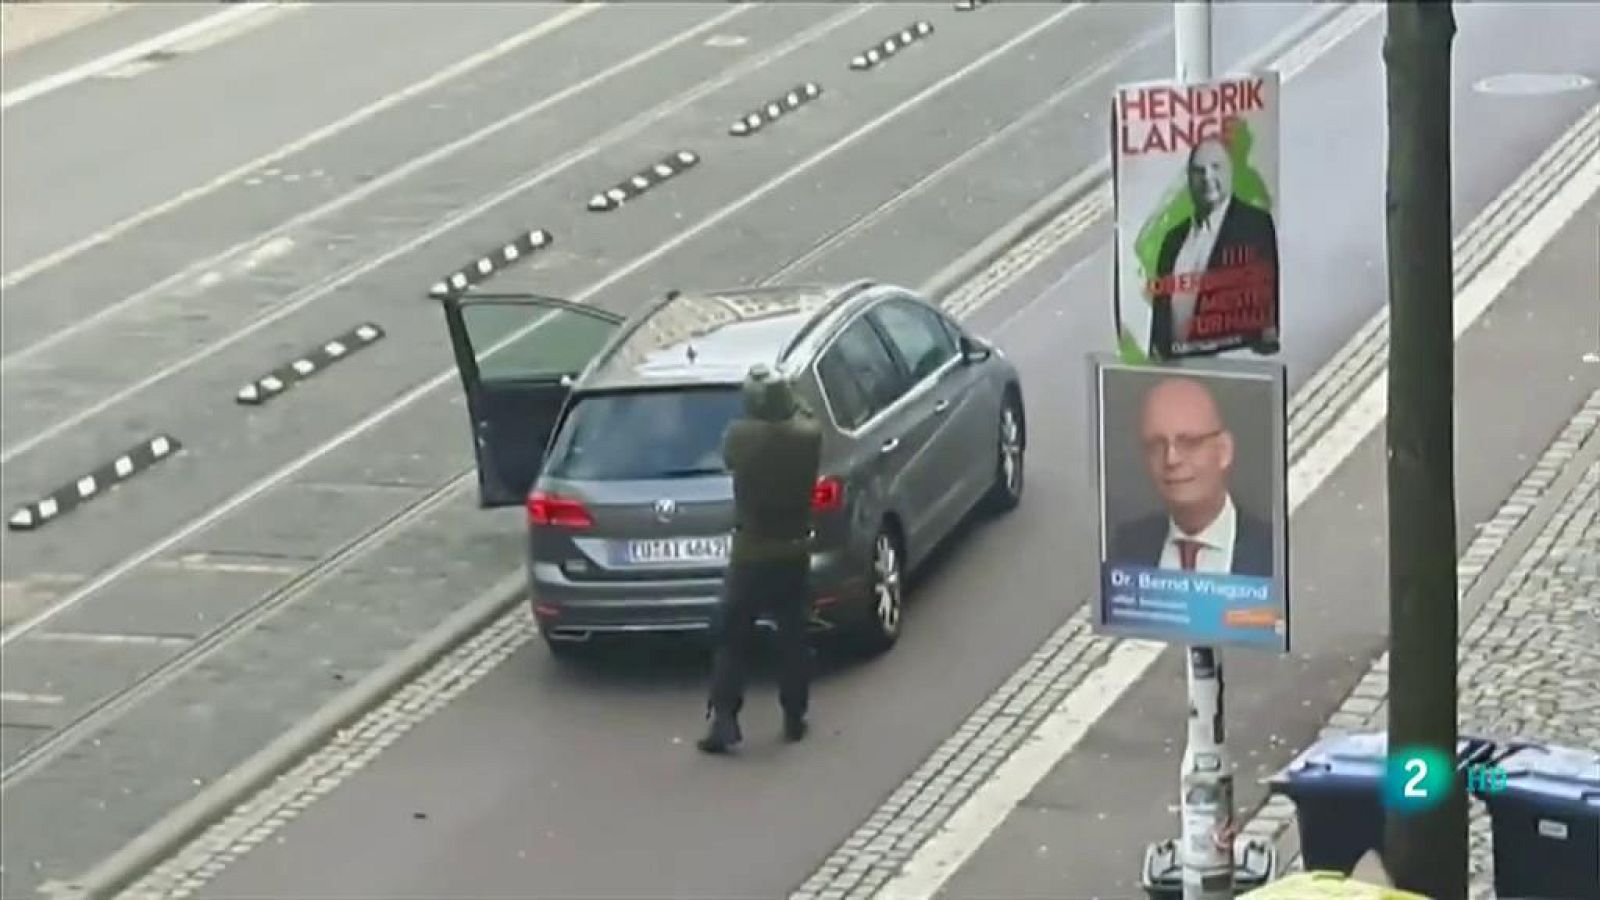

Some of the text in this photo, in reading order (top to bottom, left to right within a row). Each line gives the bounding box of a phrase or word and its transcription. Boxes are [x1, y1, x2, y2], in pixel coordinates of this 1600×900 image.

[1119, 79, 1264, 120] HENDRIK
[1111, 569, 1134, 586] Dr.
[1138, 572, 1190, 593] Bernd
